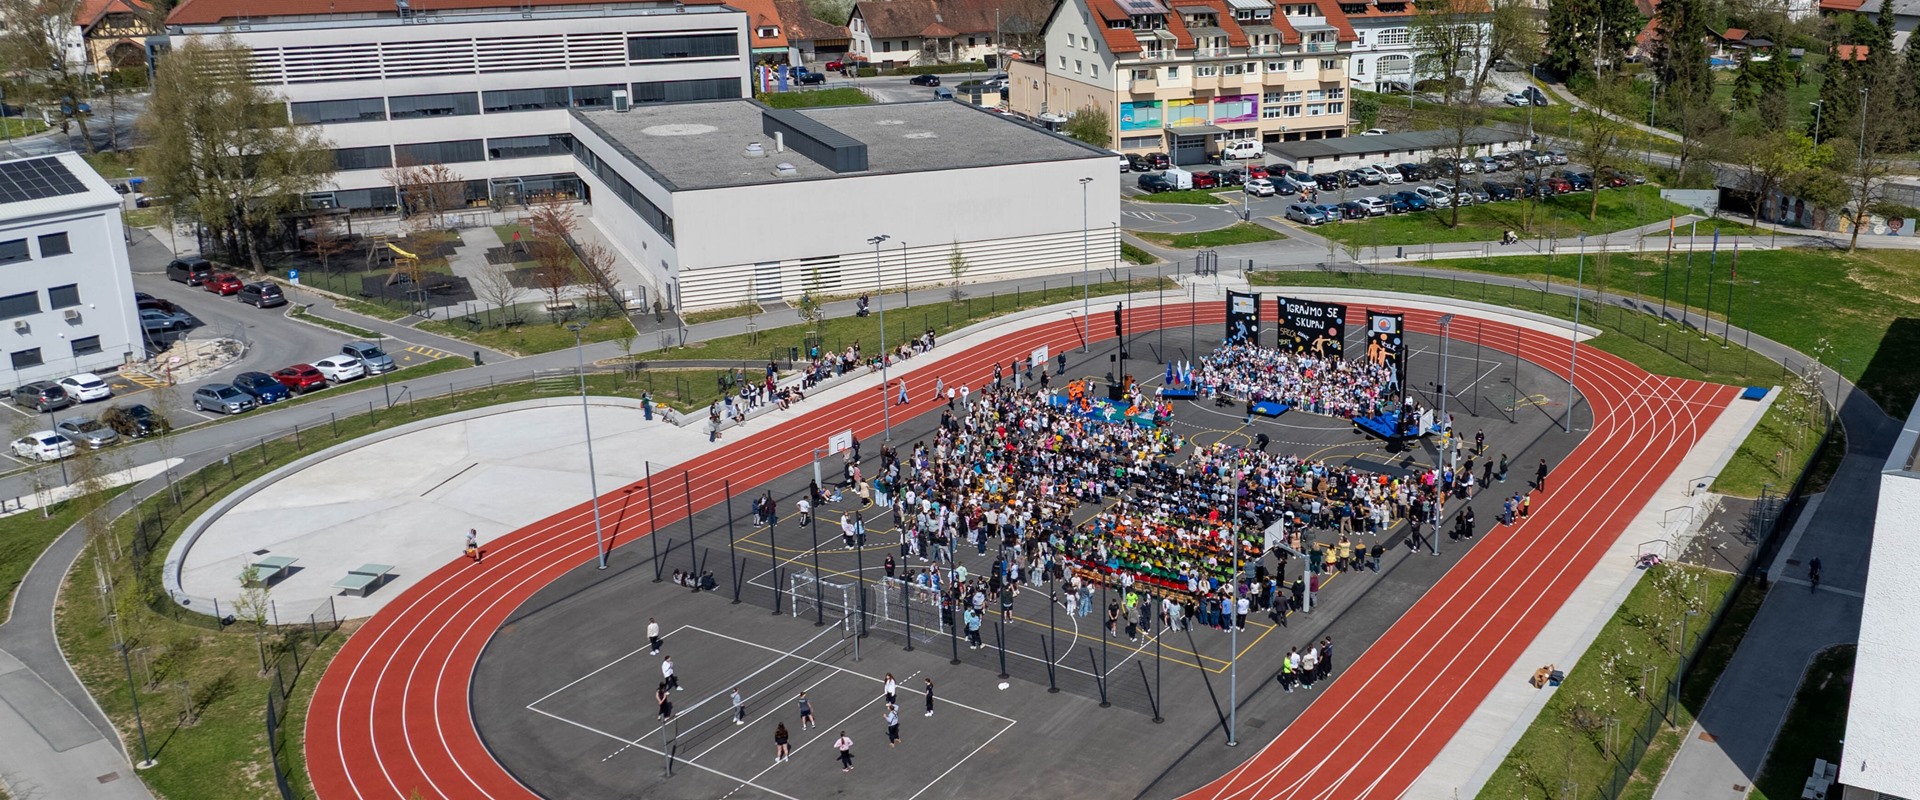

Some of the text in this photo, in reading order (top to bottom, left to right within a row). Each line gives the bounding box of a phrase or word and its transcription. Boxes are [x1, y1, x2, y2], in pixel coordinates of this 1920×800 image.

[1286, 303, 1339, 318] IGRAJMO SE
[1295, 317, 1325, 329] SKUPAJ
